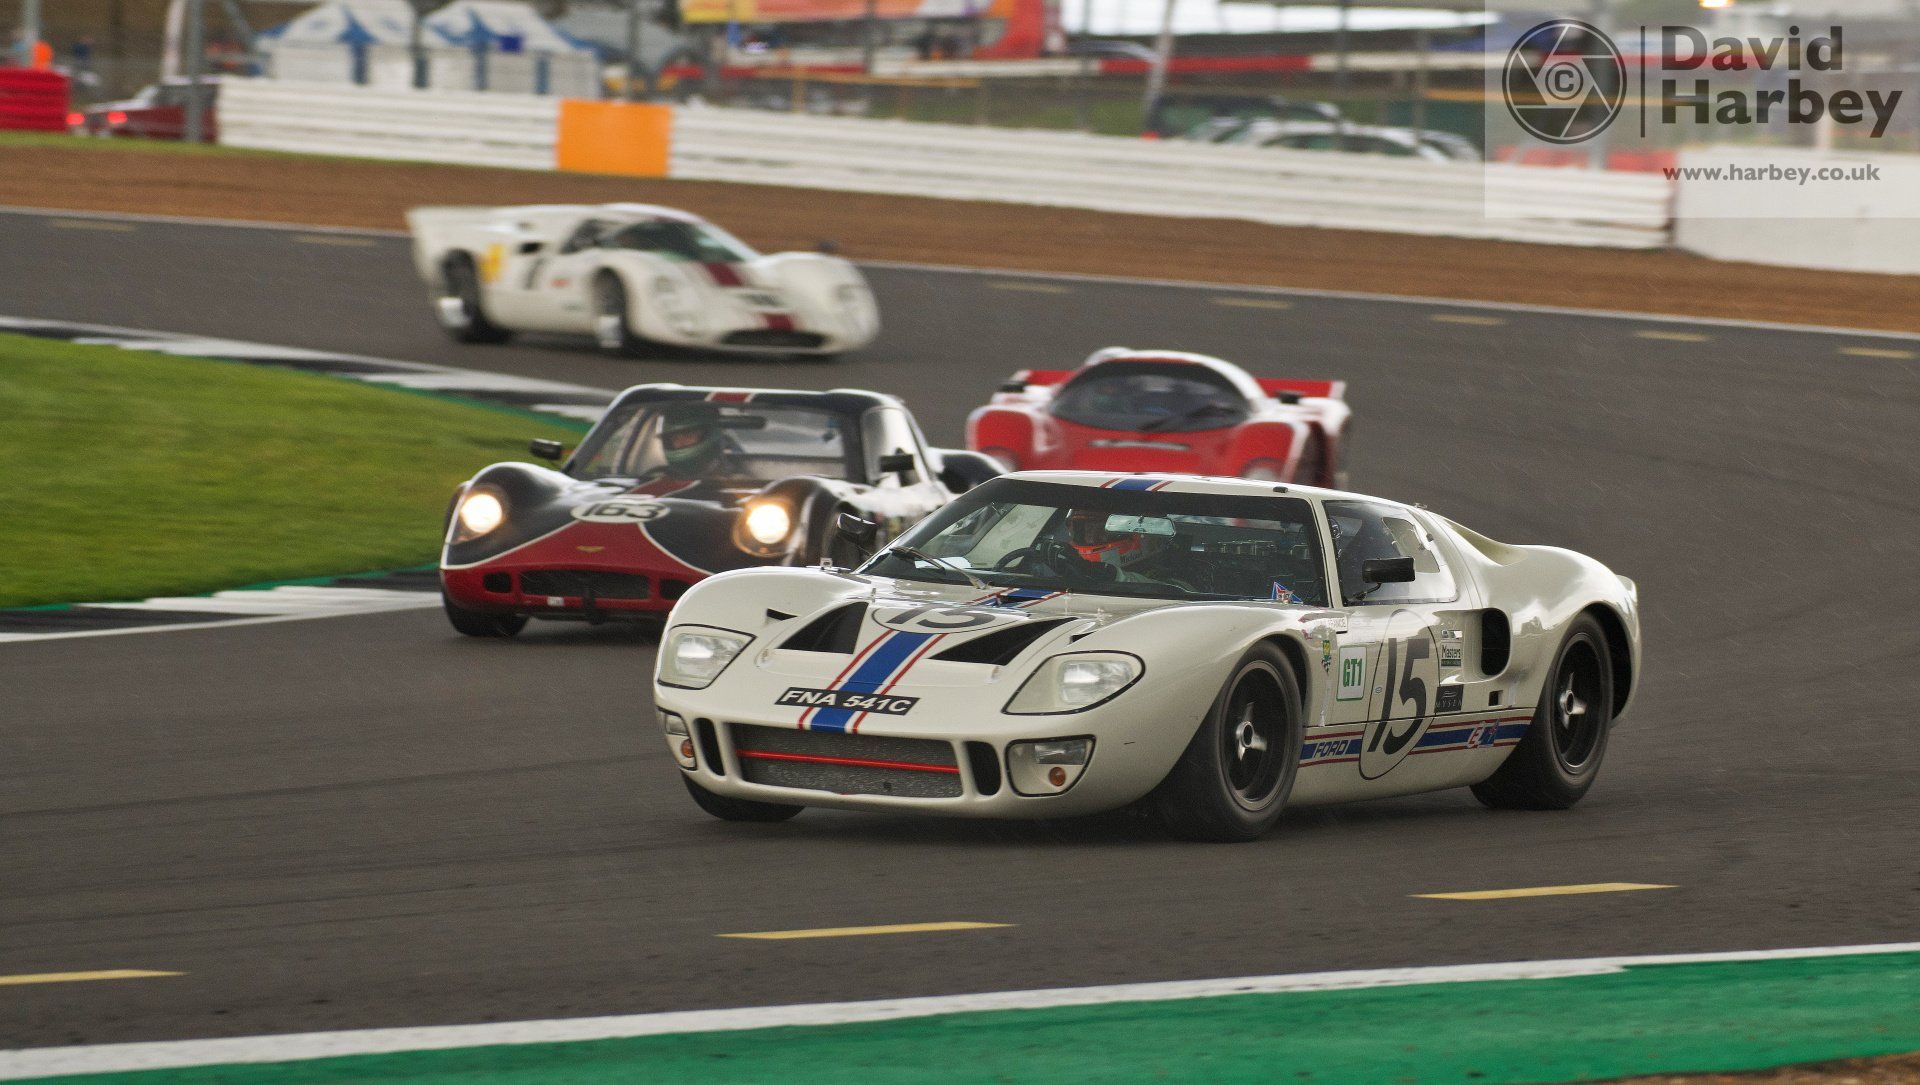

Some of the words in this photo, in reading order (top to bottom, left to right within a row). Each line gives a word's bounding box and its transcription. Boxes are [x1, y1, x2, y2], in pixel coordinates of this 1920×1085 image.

[581, 503, 666, 519] 163
[886, 603, 996, 628] 15
[1441, 644, 1461, 659] Masters
[1343, 658, 1363, 687] GT1
[780, 690, 837, 706] FNA
[842, 696, 912, 712] 541C
[1366, 637, 1430, 755] 15
[1313, 739, 1350, 758] FORD
